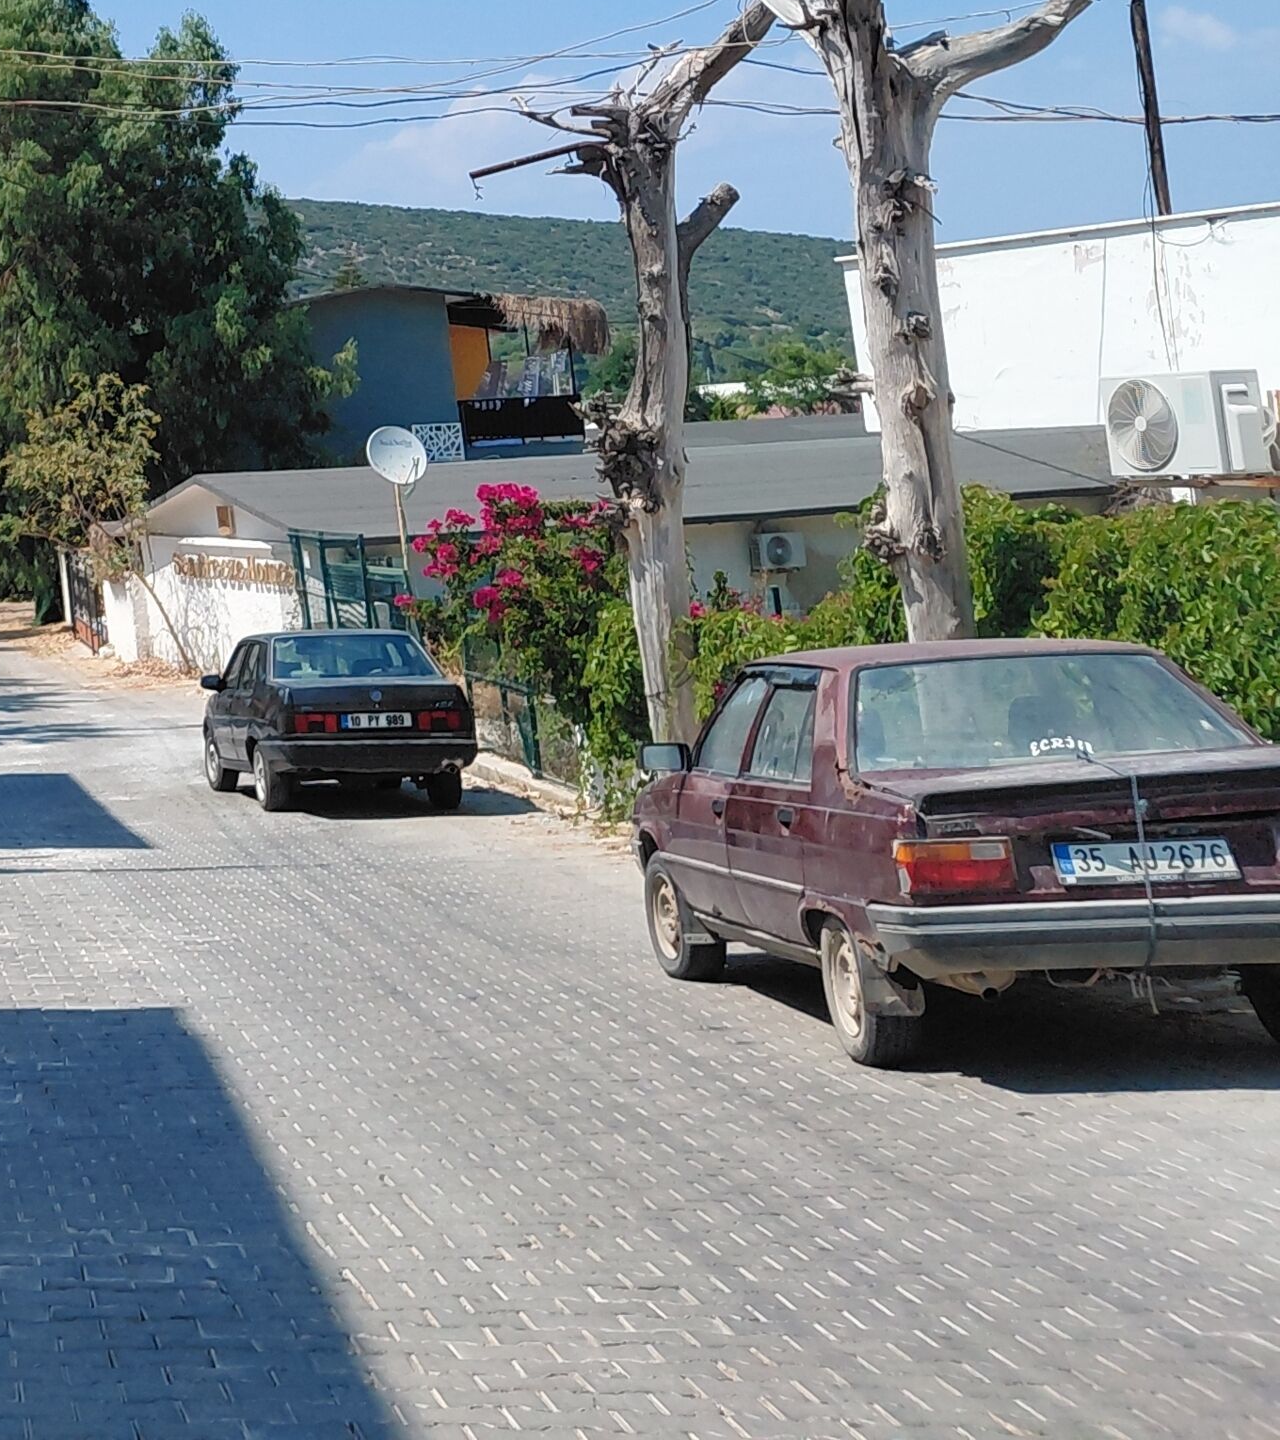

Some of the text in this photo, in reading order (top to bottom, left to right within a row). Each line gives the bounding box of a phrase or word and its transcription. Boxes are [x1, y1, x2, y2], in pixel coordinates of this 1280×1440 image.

[350, 714, 404, 727] 10 PY 989
[1074, 844, 1227, 872] 35 AJ 2676
